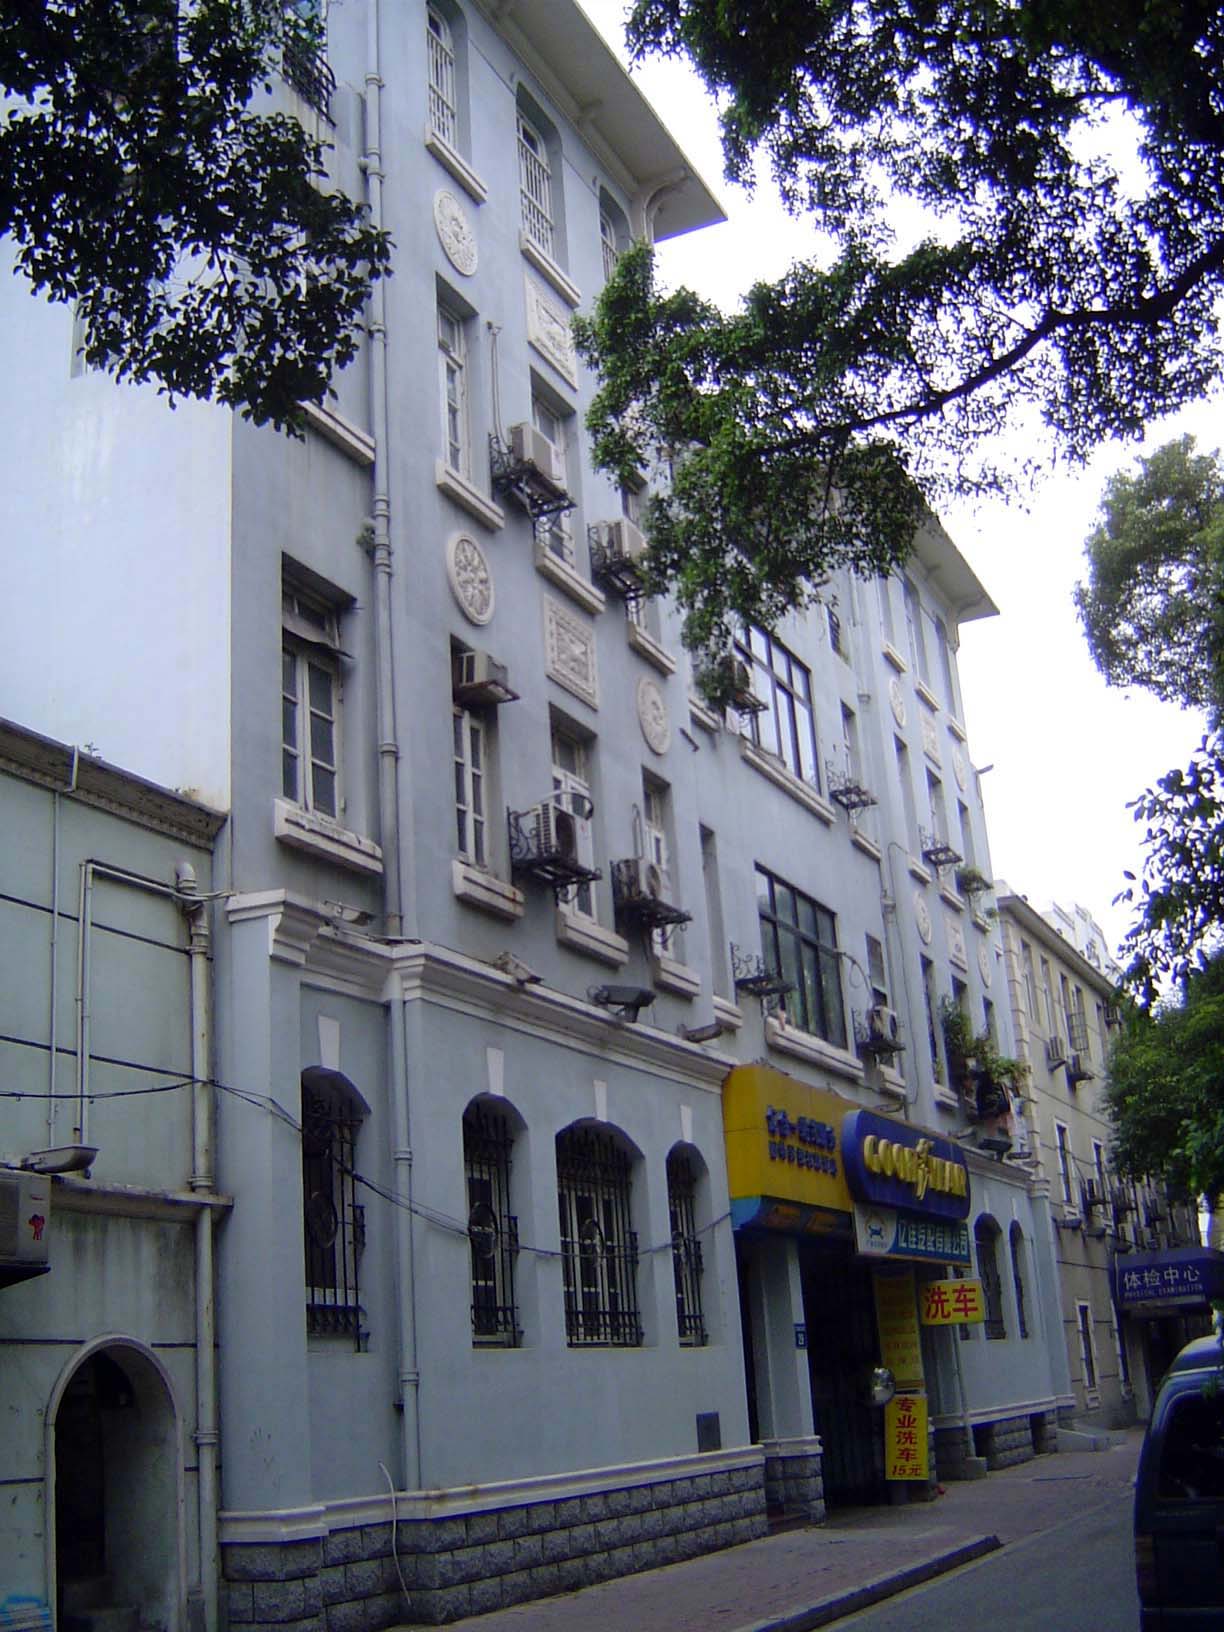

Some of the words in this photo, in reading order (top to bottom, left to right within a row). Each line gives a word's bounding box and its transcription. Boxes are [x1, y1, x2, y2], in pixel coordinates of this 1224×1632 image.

[1124, 1265, 1200, 1290] 体检中心
[925, 1284, 978, 1319] 洗车
[895, 1397, 918, 1463] 专业洗车
